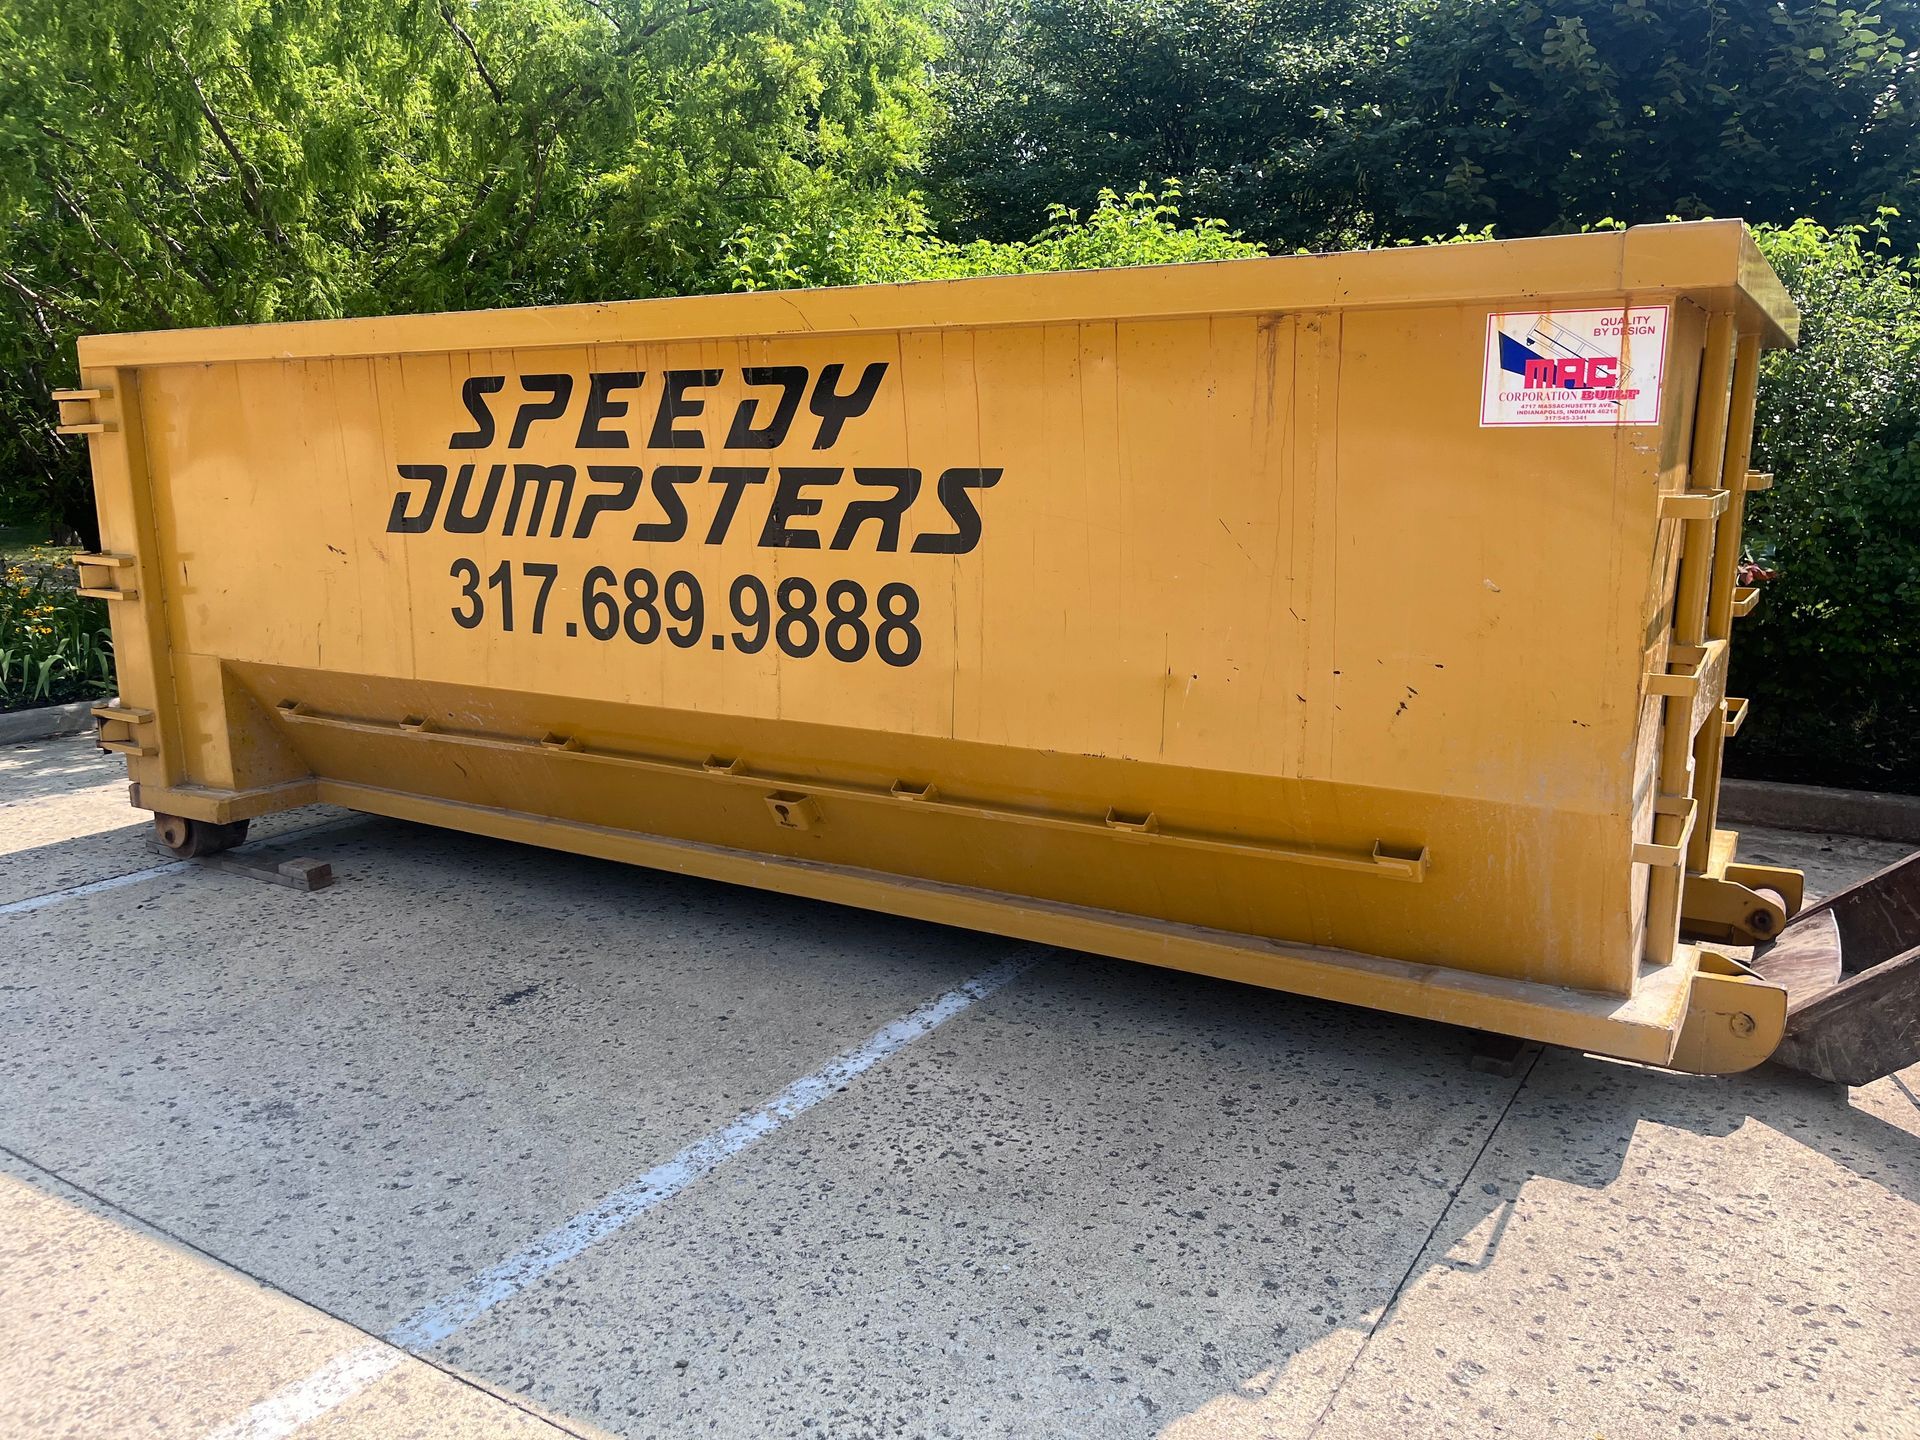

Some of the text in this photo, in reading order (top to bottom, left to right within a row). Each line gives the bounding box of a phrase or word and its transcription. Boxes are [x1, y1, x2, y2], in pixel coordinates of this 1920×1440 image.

[1593, 326, 1656, 336] BY DESIGN
[1600, 316, 1651, 326] QUALITY
[1524, 357, 1617, 389] MAC
[448, 362, 889, 450] SPEEDY
[1499, 389, 1640, 401] CORPORATION BUILT
[386, 464, 1004, 554] DUMPSTERS
[450, 557, 922, 668] 317.689.9888
